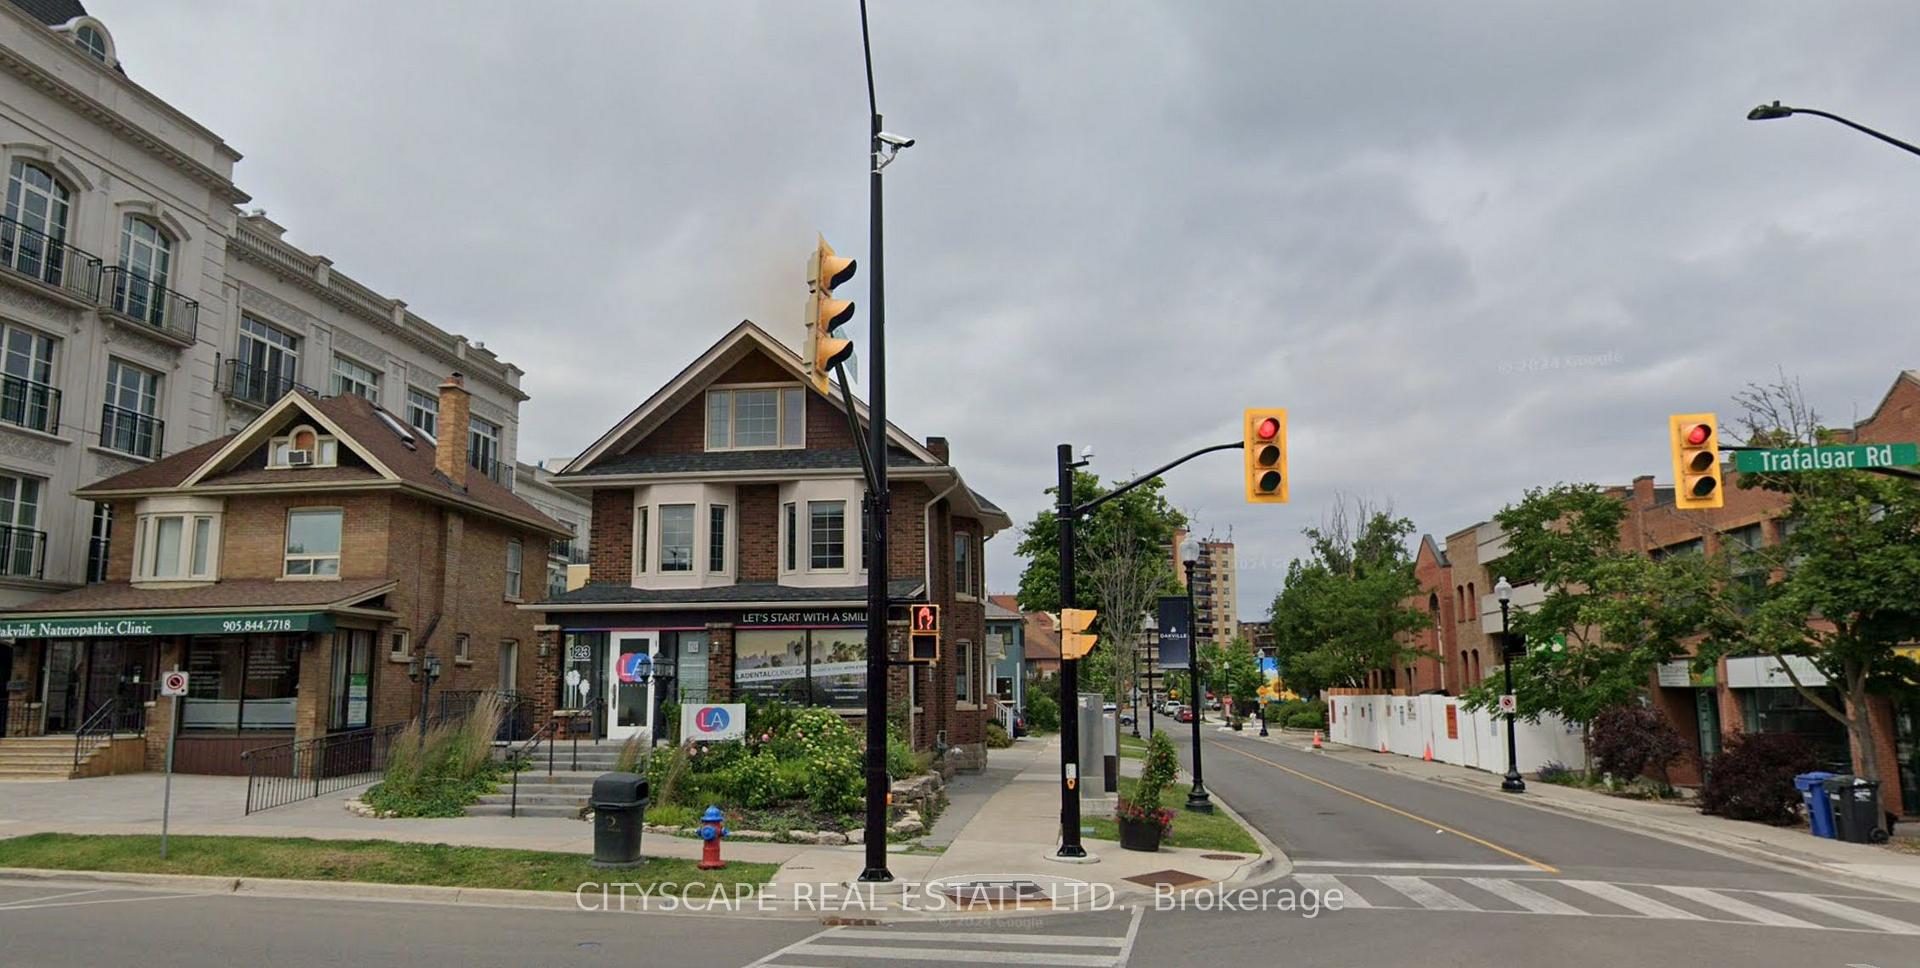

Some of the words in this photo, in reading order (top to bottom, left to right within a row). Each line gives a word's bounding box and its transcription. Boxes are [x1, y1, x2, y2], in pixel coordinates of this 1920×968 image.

[1760, 448, 1855, 471] Trafalgar
[1866, 445, 1892, 467] Rd
[742, 613, 769, 623] LET'S
[770, 612, 800, 622] START
[802, 612, 830, 622] WITH
[831, 612, 840, 621] A
[841, 612, 868, 622] SMIL
[0, 623, 36, 637] akville
[39, 621, 115, 636] Naturopathic
[117, 621, 152, 634] Clinic
[222, 619, 291, 632] 905.844.7718
[570, 645, 591, 658] 123
[701, 712, 723, 727] LA
